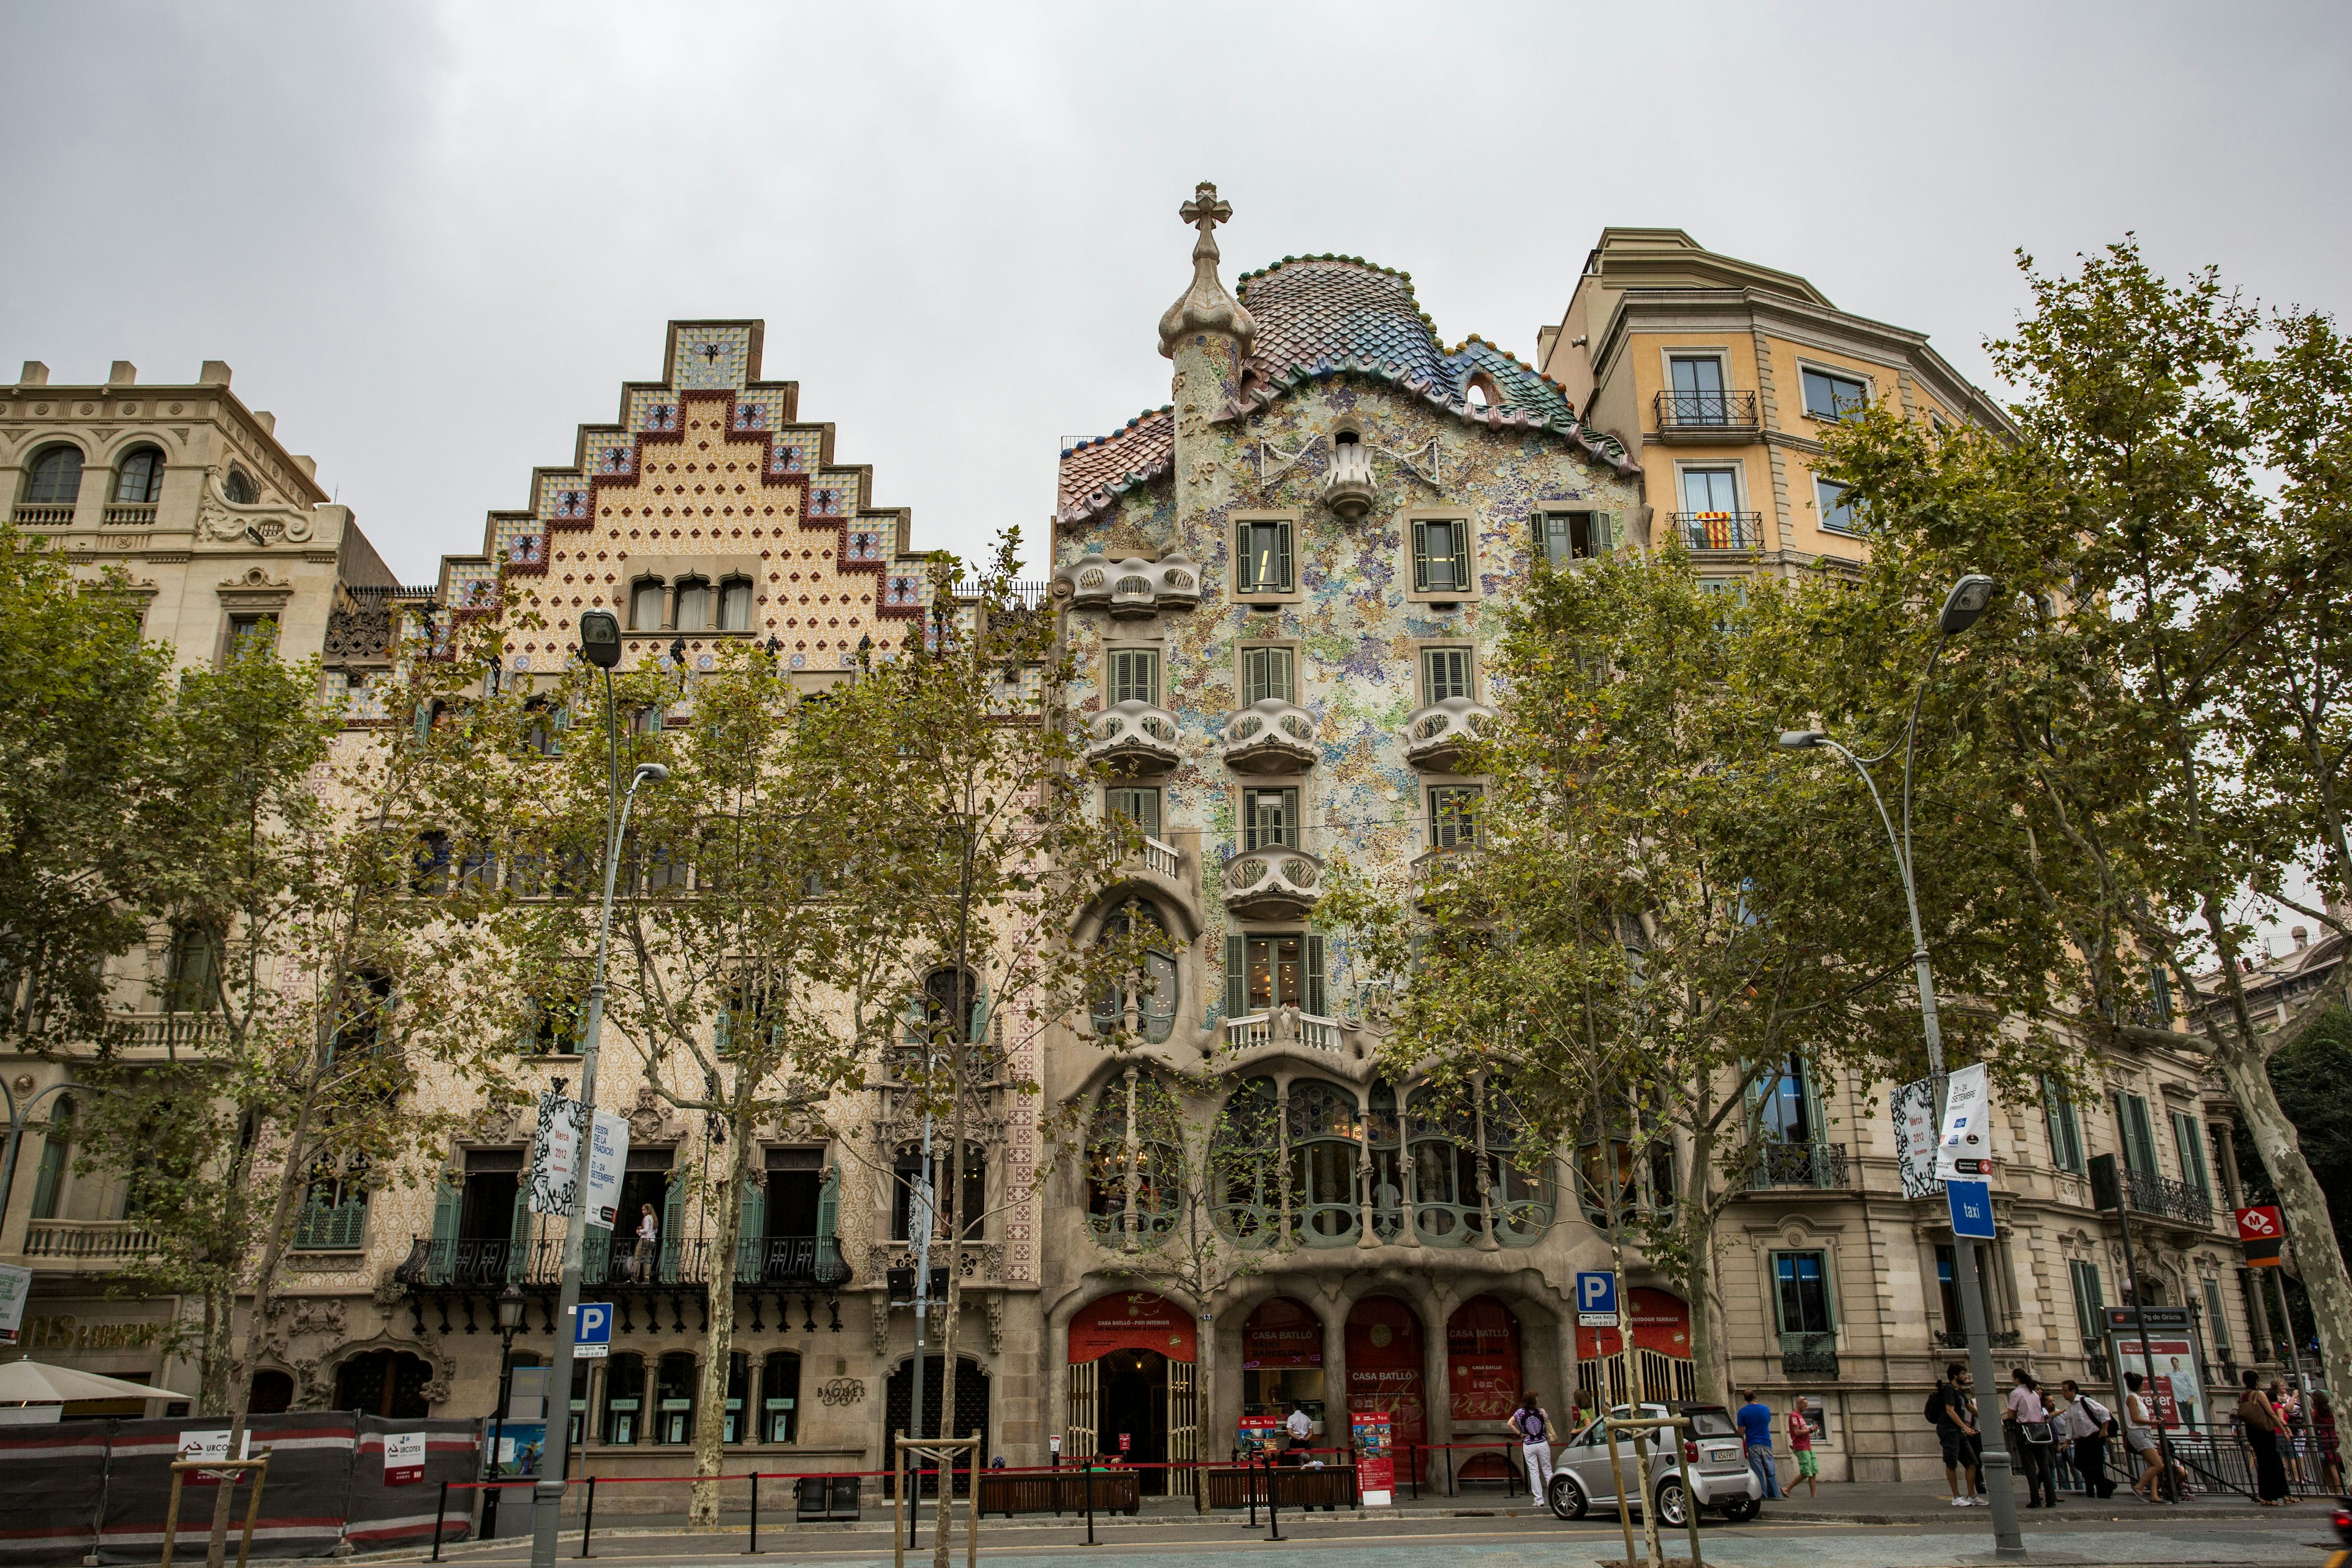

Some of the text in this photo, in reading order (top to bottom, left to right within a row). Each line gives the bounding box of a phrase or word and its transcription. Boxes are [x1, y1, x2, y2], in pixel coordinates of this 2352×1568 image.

[1962, 1084, 1967, 1092] 24
[1951, 1090, 1976, 1103] SETEMBRE
[1909, 1115, 1923, 1126] Mercè
[555, 1129, 570, 1142] Mercè
[595, 1125, 608, 1136] FESTA
[594, 1134, 606, 1145] DE LA
[1913, 1132, 1924, 1143] 2012
[555, 1148, 567, 1159] 2012
[593, 1142, 614, 1156] TRADICIÓ
[592, 1161, 595, 1169] 21
[590, 1170, 615, 1184] SETEMBRE
[1964, 1202, 1980, 1219] taxi
[2248, 1215, 2261, 1226] M
[1584, 1276, 1607, 1308] P
[581, 1308, 604, 1340] P
[1280, 1330, 1313, 1340] BATLLÓ
[1476, 1328, 1509, 1337] BATLLÓ
